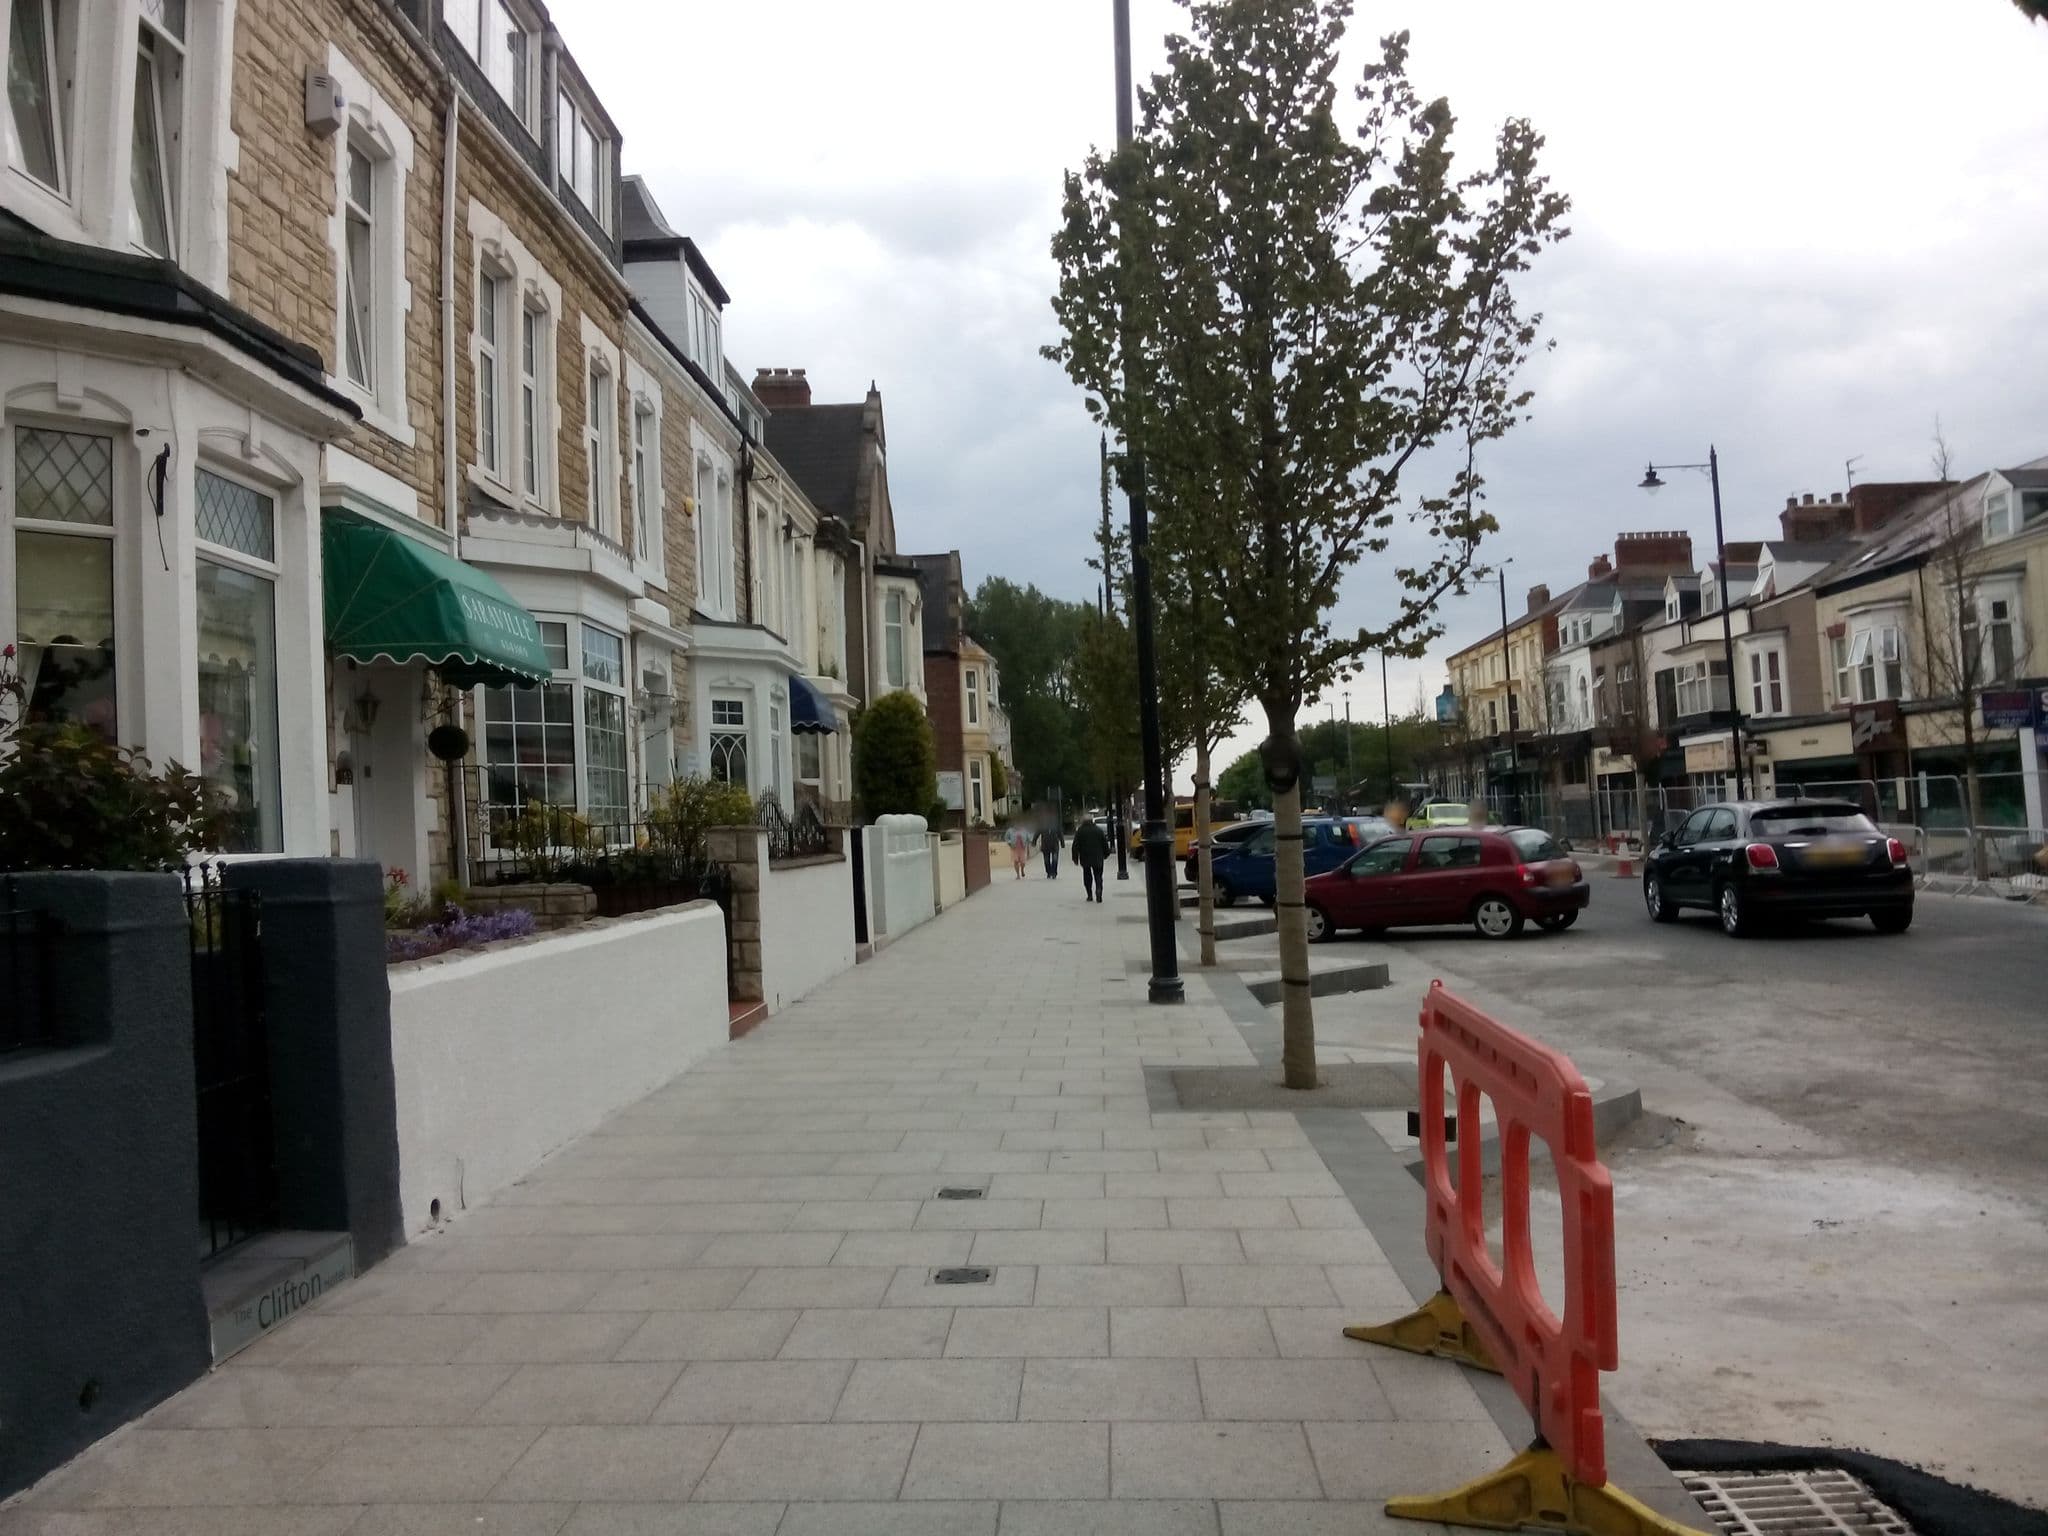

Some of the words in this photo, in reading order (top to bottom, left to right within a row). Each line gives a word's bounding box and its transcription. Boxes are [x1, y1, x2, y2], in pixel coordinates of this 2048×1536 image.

[461, 594, 534, 642] SARAVILLE
[232, 1307, 253, 1328] The
[258, 1273, 322, 1329] Clifton
